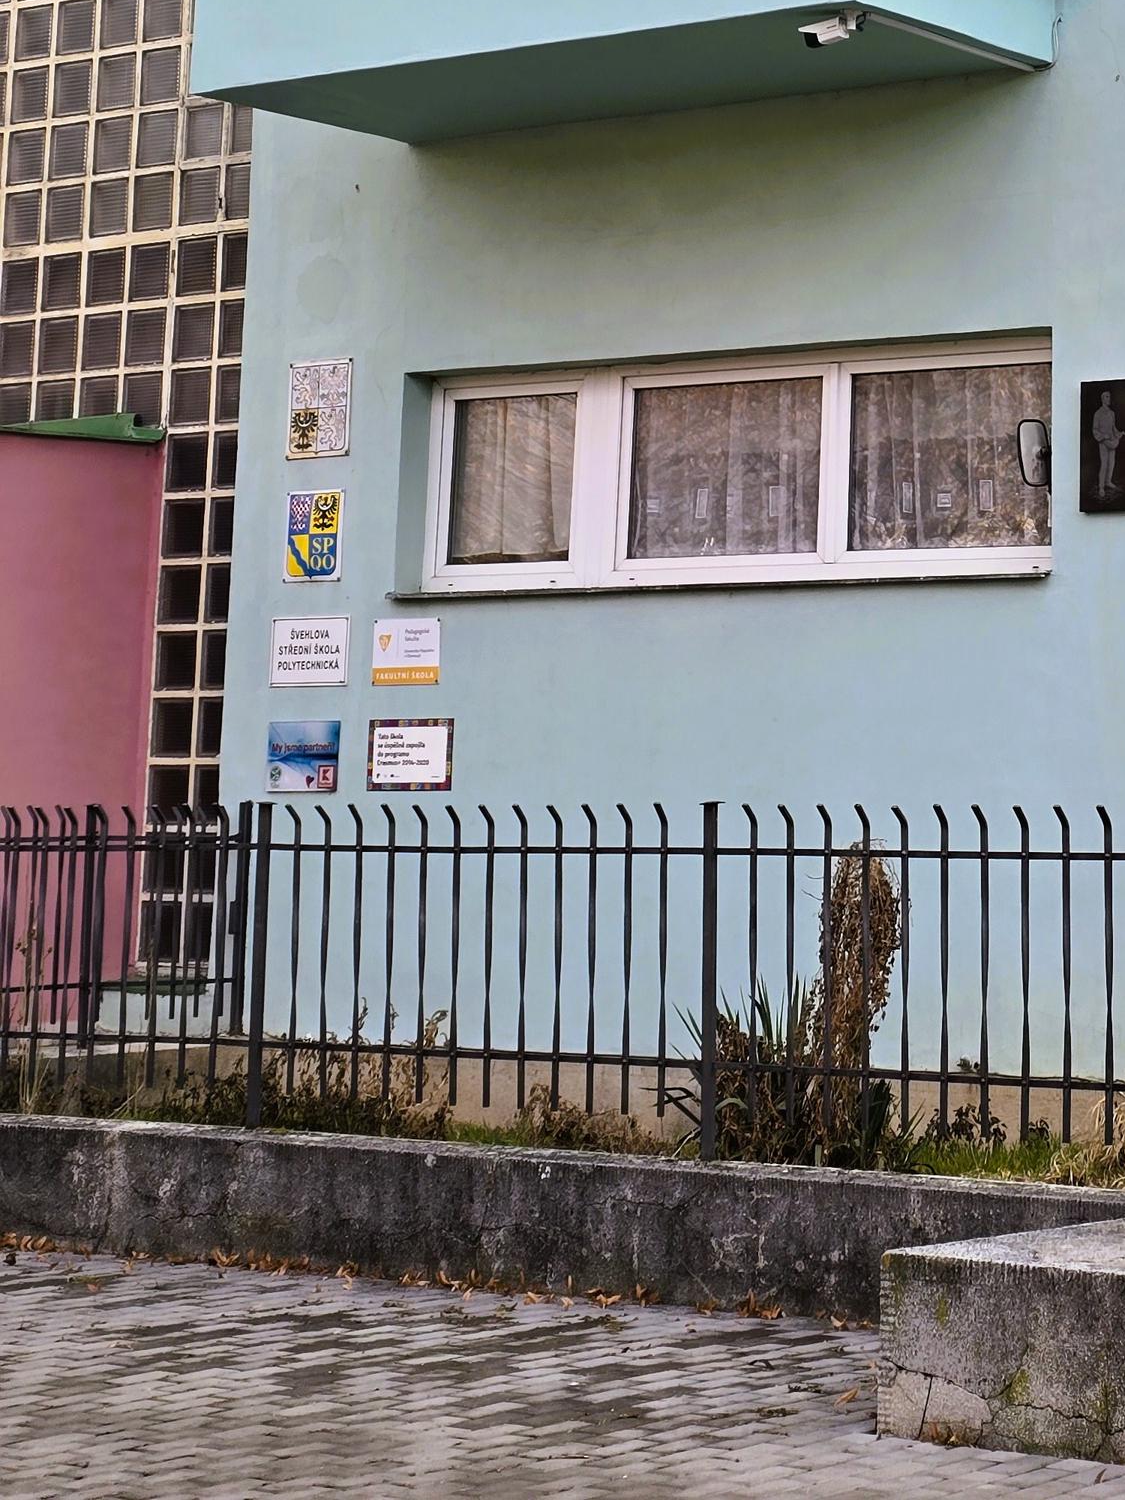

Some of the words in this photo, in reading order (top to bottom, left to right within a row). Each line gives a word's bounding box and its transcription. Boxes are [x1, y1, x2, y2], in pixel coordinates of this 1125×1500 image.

[312, 537, 334, 554] SP
[310, 554, 335, 571] QO
[290, 628, 329, 640] ŠVEHLOVA
[278, 643, 312, 655] STŘEDNÍ
[313, 643, 340, 654] ŠKOLA
[277, 658, 339, 671] POLYTECHNICKÁ
